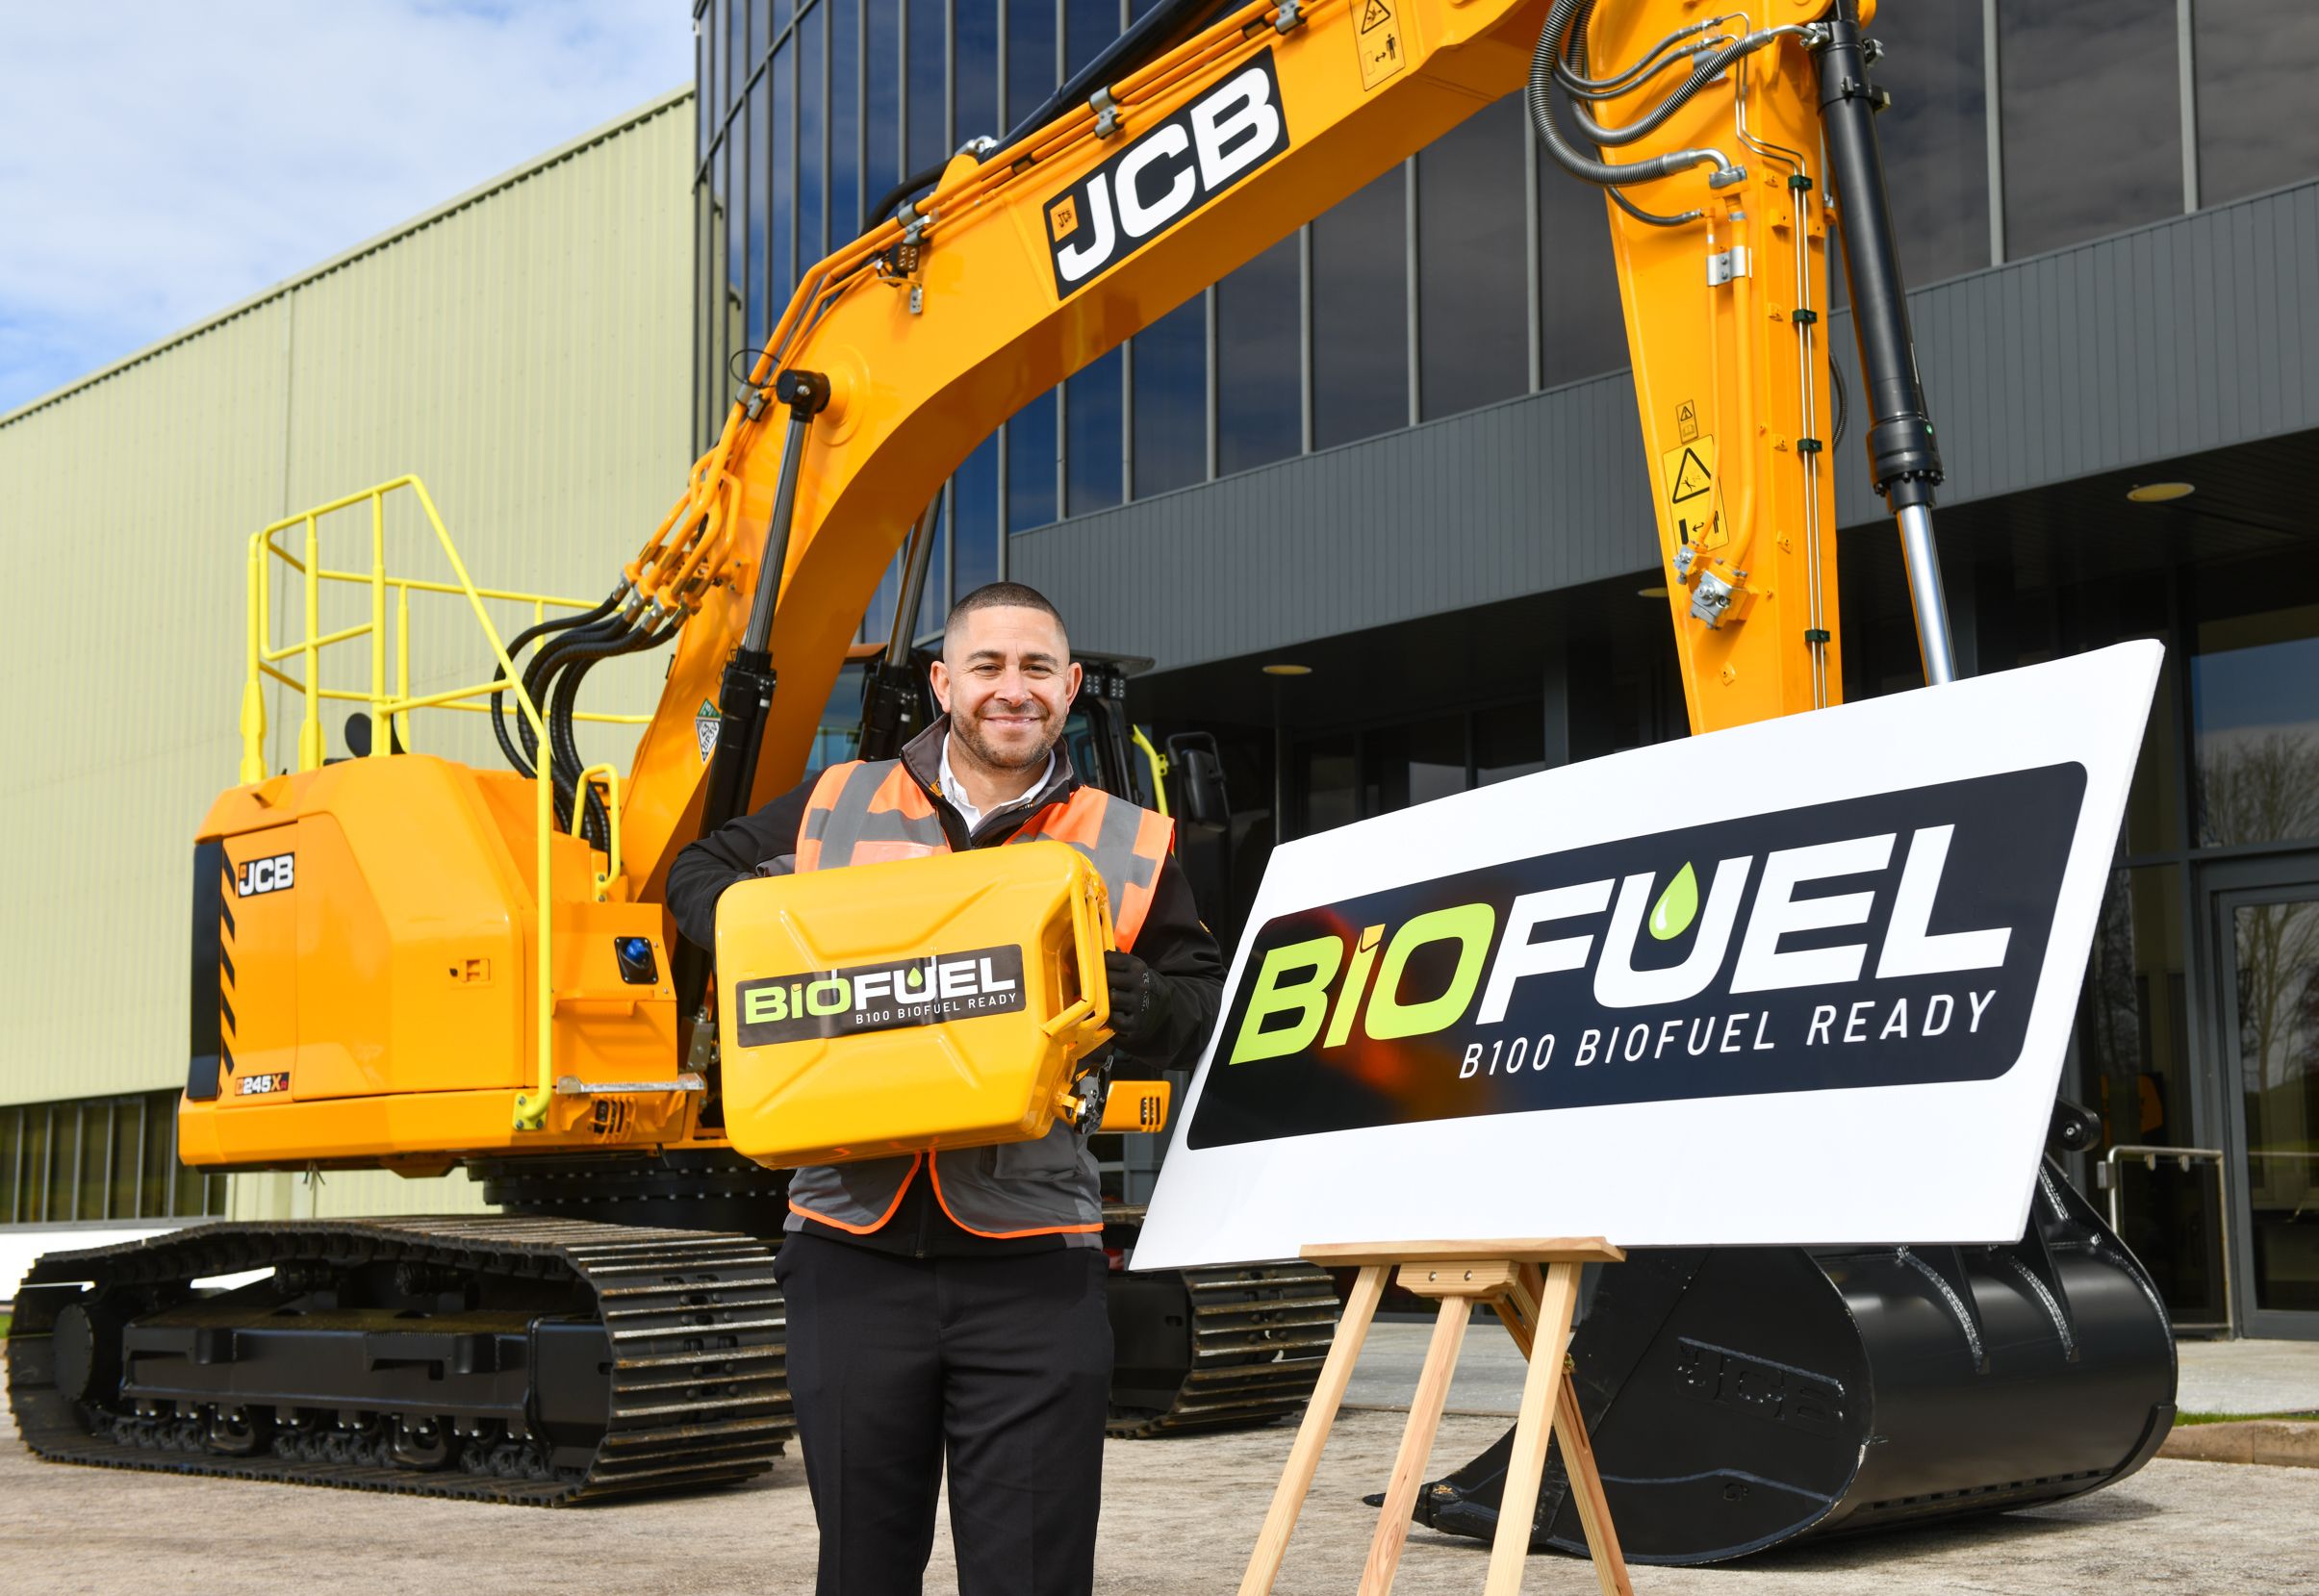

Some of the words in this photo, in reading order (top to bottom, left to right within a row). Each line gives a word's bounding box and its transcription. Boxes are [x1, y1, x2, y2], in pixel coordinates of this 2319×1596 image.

[1058, 67, 1280, 281] JCB
[239, 854, 293, 896] JCB
[855, 1010, 891, 1025] B100
[898, 1001, 961, 1020] BIOFUEL
[968, 993, 1017, 1009] READY
[1459, 1034, 1555, 1078] B100
[1575, 1011, 1775, 1067] BIOFUEL
[1807, 990, 1997, 1046] READY
